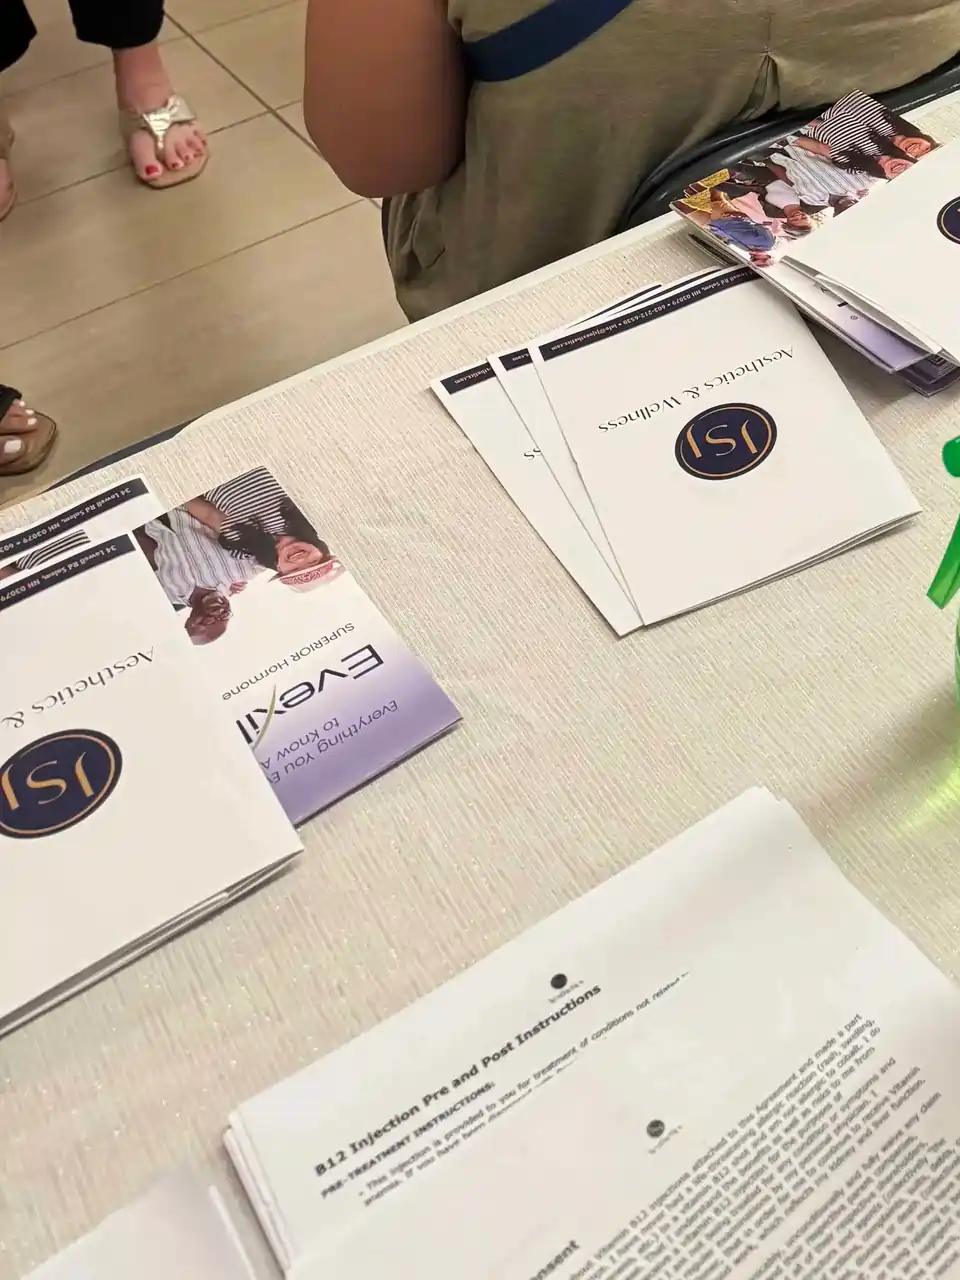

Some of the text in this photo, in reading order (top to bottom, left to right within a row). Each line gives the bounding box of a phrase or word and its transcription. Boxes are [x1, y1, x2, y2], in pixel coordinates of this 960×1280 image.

[598, 345, 794, 433] Aesthetics & Wellness
[95, 491, 120, 508] Lowell
[119, 485, 131, 496] 34
[59, 508, 85, 525] Salem,
[83, 503, 96, 513] Rd
[21, 527, 47, 544] 03079
[46, 520, 60, 531] NH
[78, 547, 105, 566] Lowell
[104, 543, 117, 554] 34
[40, 564, 67, 583] Salem,
[66, 559, 80, 570] Rd
[26, 577, 40, 589] NH
[219, 619, 355, 703] SUPERIOR Hormone
[1, 645, 155, 730] Aesthetics &
[234, 640, 386, 745] Evexi
[314, 697, 400, 755] Everything
[320, 715, 341, 734] to
[273, 727, 321, 761] Know
[281, 749, 316, 776] You
[842, 1011, 864, 1032] part
[313, 1148, 348, 1177] B12
[347, 1100, 422, 1157] Injection
[420, 1083, 450, 1107] Pre
[449, 1063, 480, 1089] and
[479, 1040, 516, 1068] Post
[513, 981, 603, 1046] Instructions
[782, 1068, 818, 1102] reaction
[388, 1143, 432, 1177] injection
[441, 1108, 485, 1141] provided
[497, 1087, 517, 1105] you
[516, 1076, 533, 1091] for
[531, 1045, 578, 1081] treatment
[319, 1133, 413, 1199] PRE-TREATMENT
[411, 1078, 497, 1139] INSTRUCTIONS:
